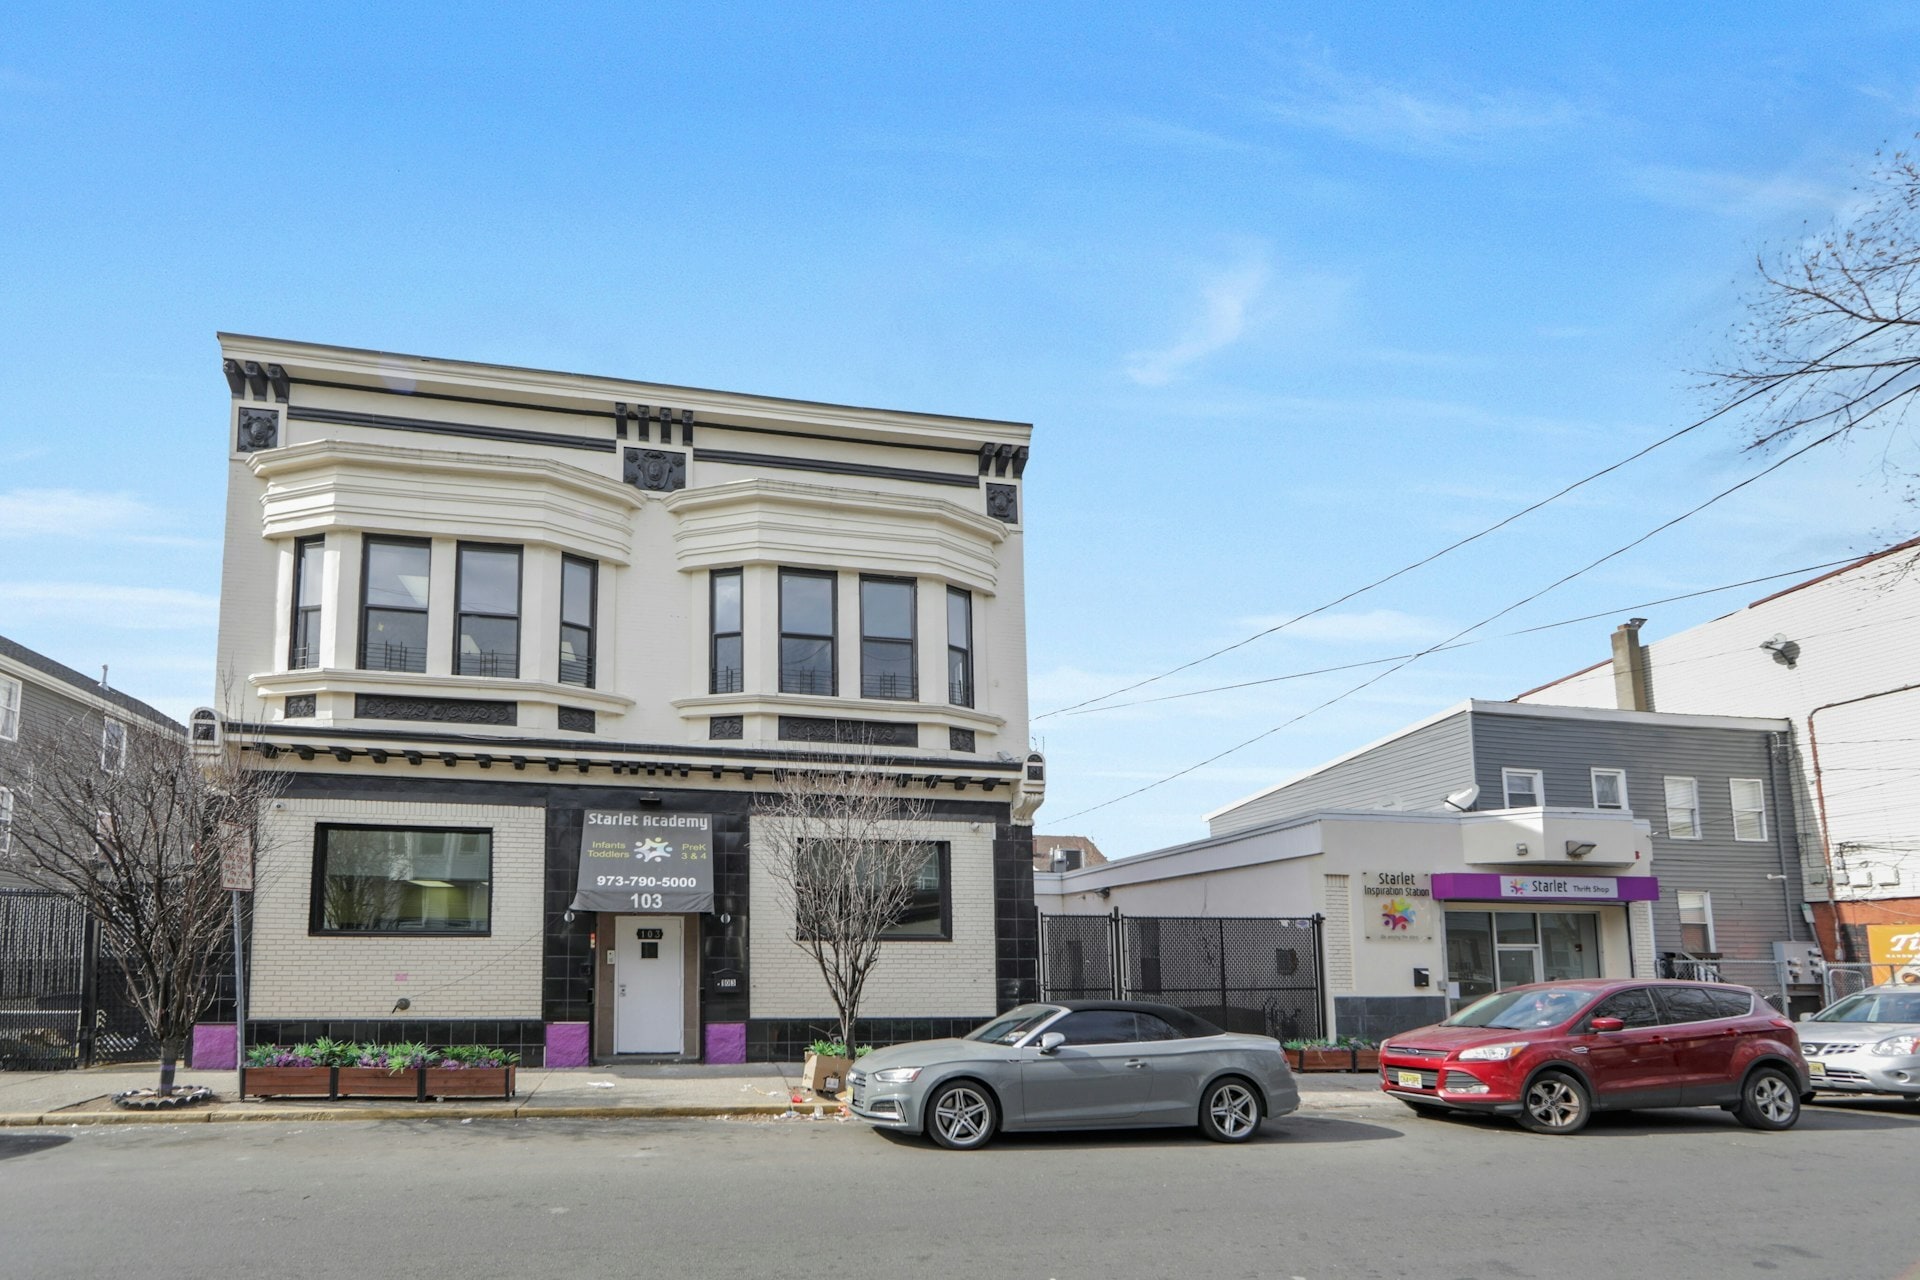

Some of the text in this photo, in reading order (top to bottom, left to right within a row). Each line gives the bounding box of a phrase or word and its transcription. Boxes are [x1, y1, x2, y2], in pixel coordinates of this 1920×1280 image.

[588, 812, 708, 830] Starlet Academy
[592, 841, 626, 849] Infants
[682, 843, 707, 851] PreK
[588, 850, 630, 858] Toddlers
[596, 875, 697, 888] 973-790-5000
[1378, 871, 1416, 886] Starlet
[1364, 885, 1430, 897] Inspiration Station
[1532, 880, 1610, 894] Starlet Thrift Shop
[630, 893, 663, 909] 103
[641, 930, 661, 938] 103
[1890, 932, 1920, 952] Ti
